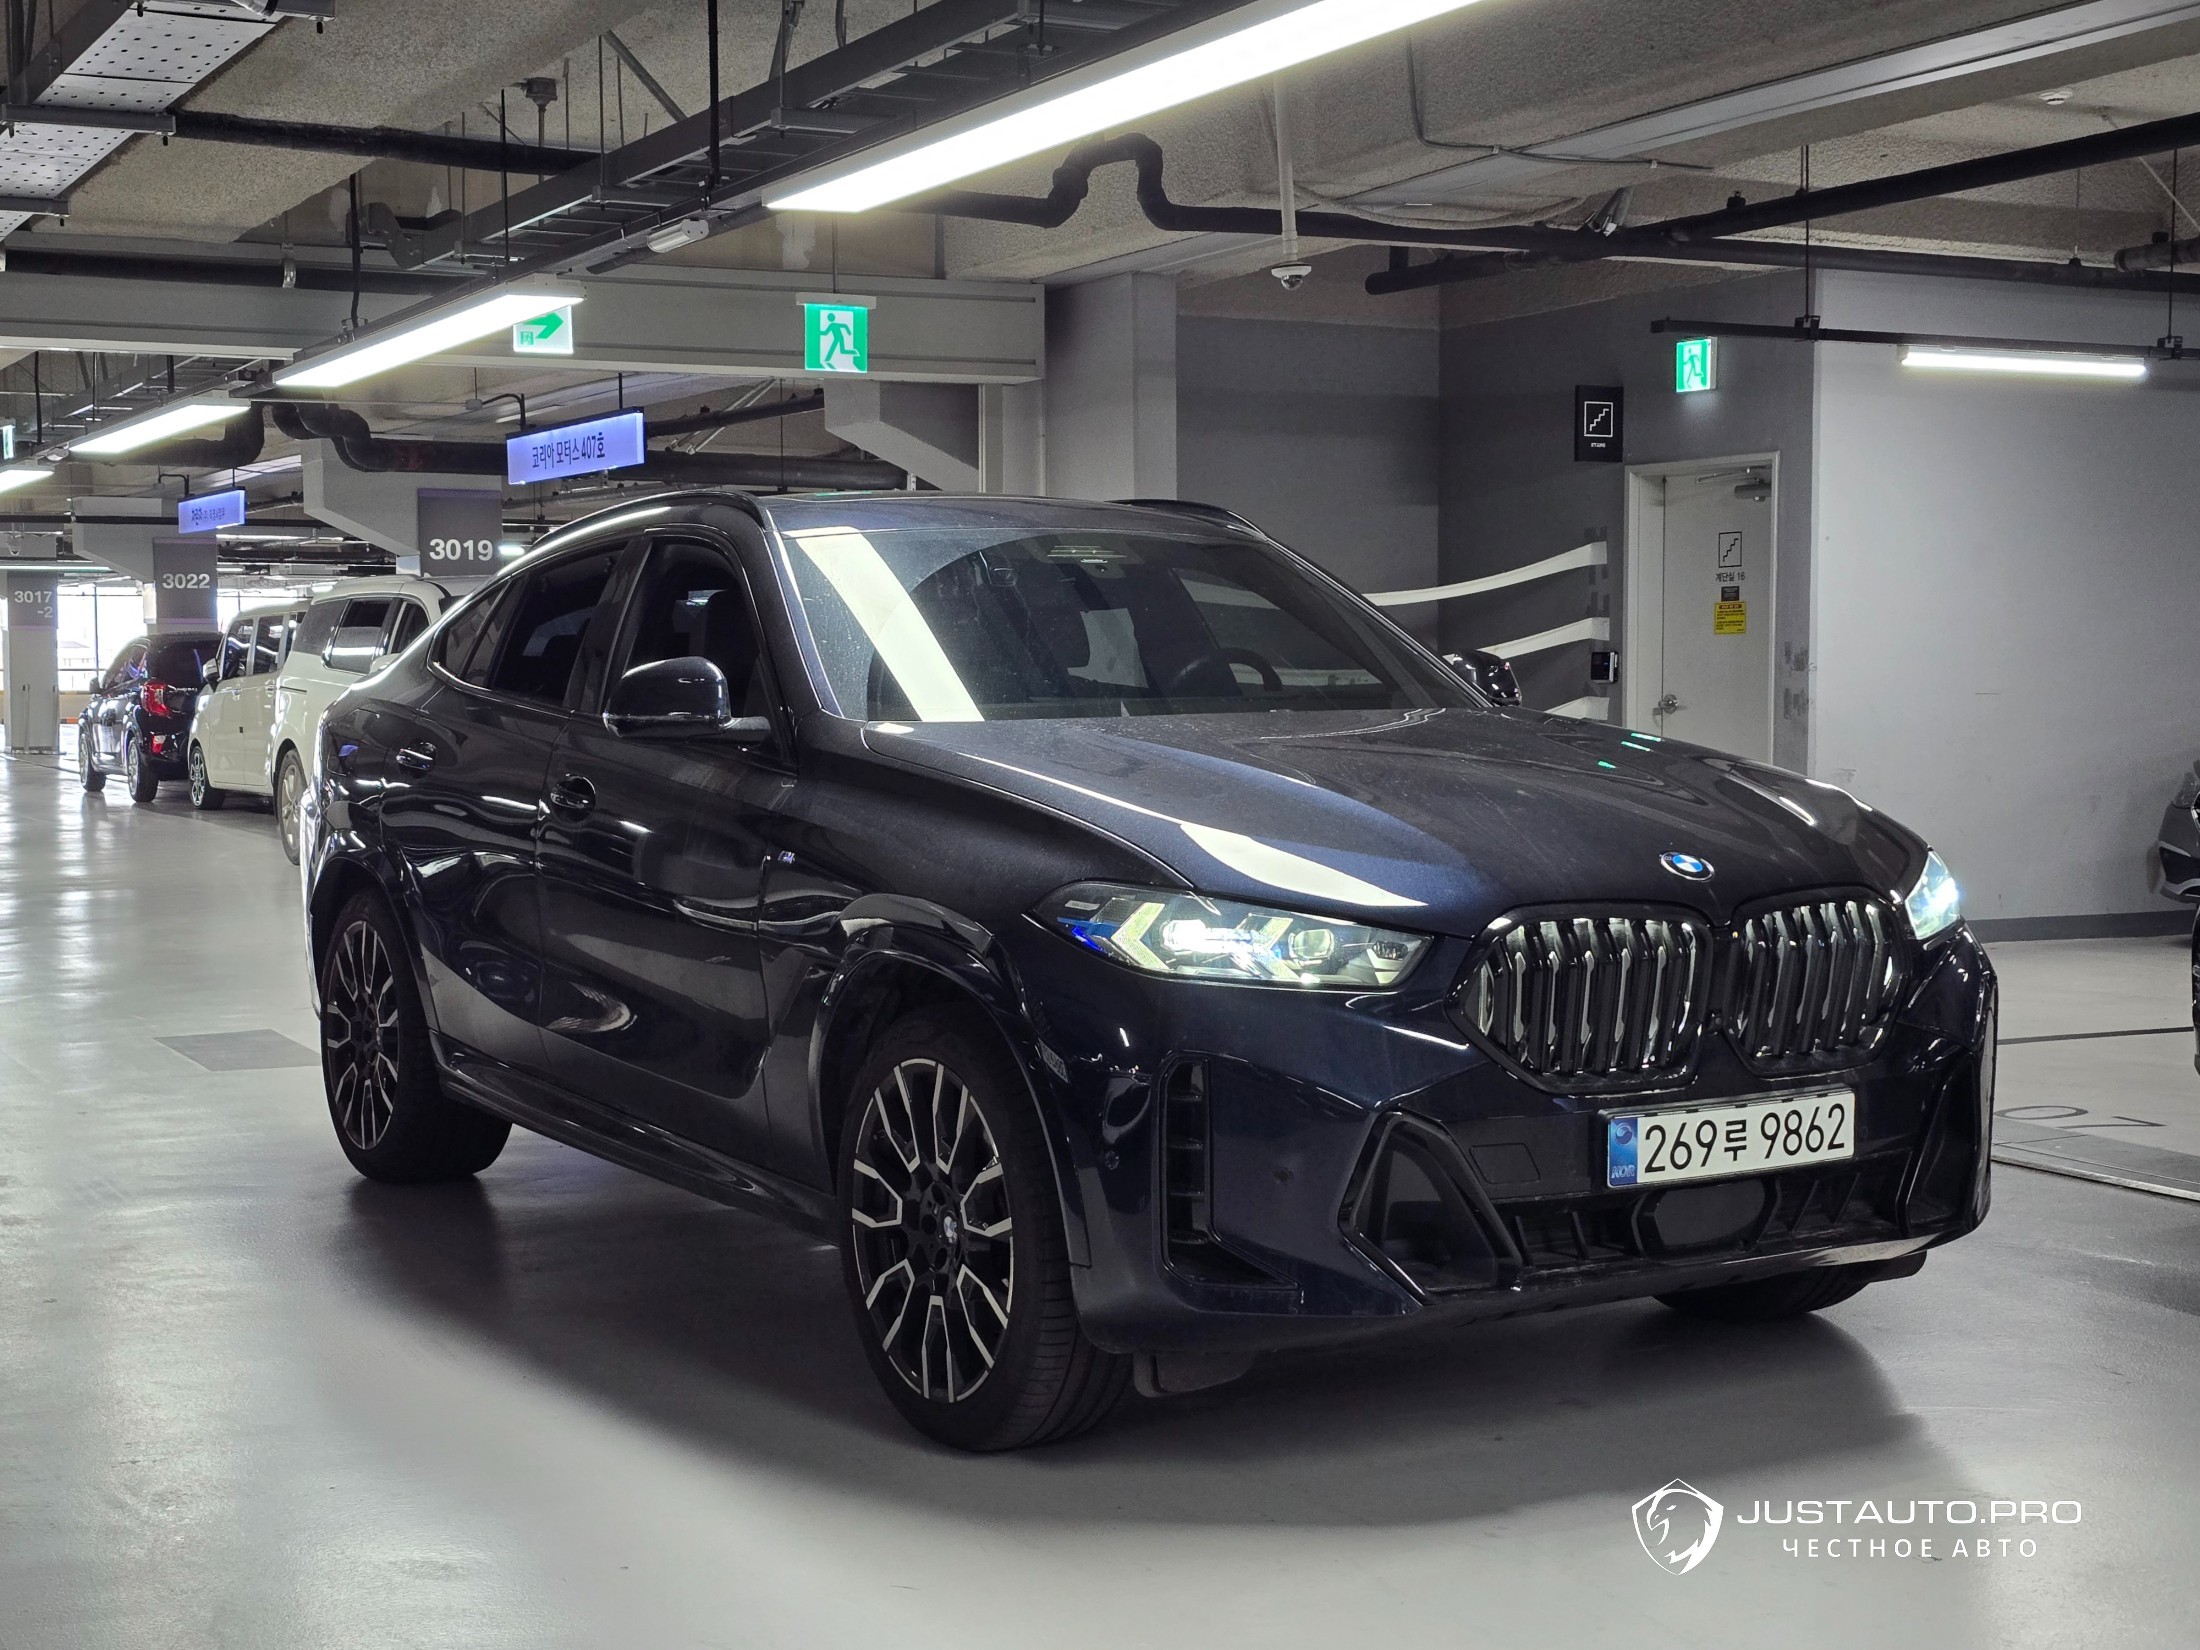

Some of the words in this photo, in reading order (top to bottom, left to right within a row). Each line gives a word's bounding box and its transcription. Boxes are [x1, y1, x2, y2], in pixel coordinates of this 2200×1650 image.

[532, 442, 555, 470] 코리아
[556, 438, 580, 465] 모터스
[581, 431, 606, 460] 407호
[429, 538, 493, 561] 3019
[162, 573, 211, 589] 3022
[14, 590, 53, 604] 3017
[37, 606, 54, 619] -2
[1644, 1119, 1747, 1174] 269루
[1760, 1103, 1846, 1160] 9862
[1610, 1164, 1637, 1179] KOR
